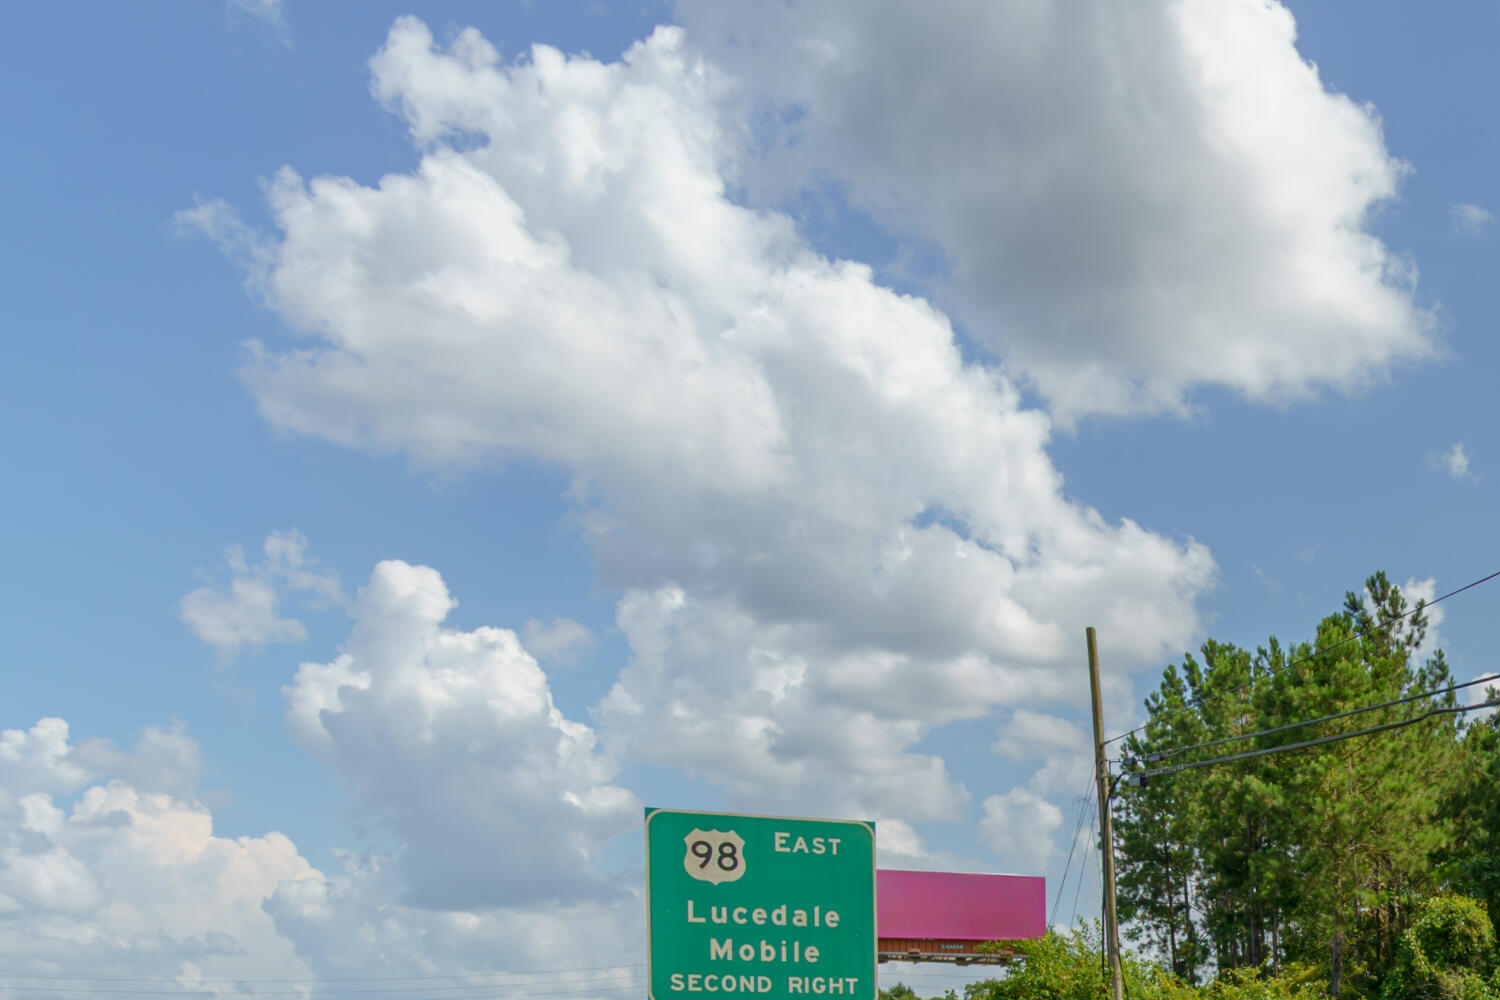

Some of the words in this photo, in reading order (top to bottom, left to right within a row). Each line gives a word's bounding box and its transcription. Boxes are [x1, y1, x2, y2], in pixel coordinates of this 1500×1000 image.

[690, 839, 740, 872] 98
[774, 831, 841, 855] EAST
[687, 900, 840, 928] Lucedale
[710, 938, 820, 963] Mobile
[670, 973, 772, 993] SECOND
[788, 976, 859, 995] RIGHT
